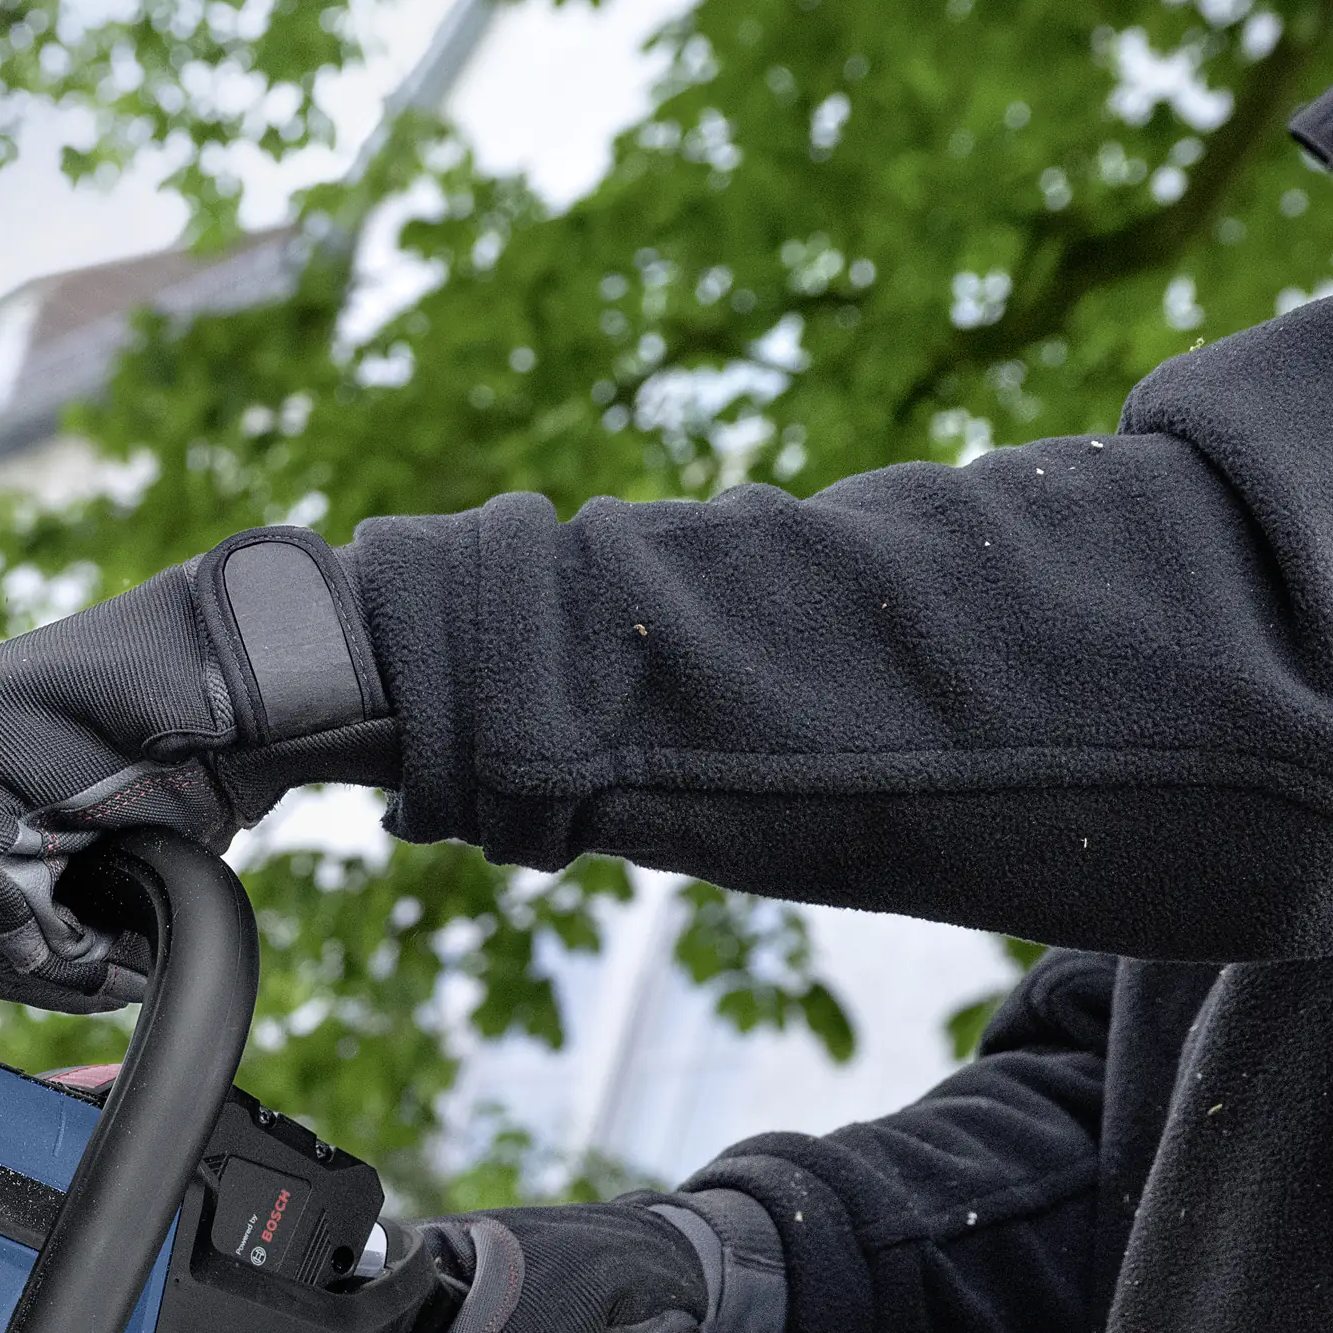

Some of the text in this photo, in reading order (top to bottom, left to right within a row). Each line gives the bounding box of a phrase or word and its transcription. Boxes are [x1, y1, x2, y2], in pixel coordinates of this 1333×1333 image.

[235, 1213, 258, 1256] Powered by
[261, 1189, 291, 1243] BOSCH
